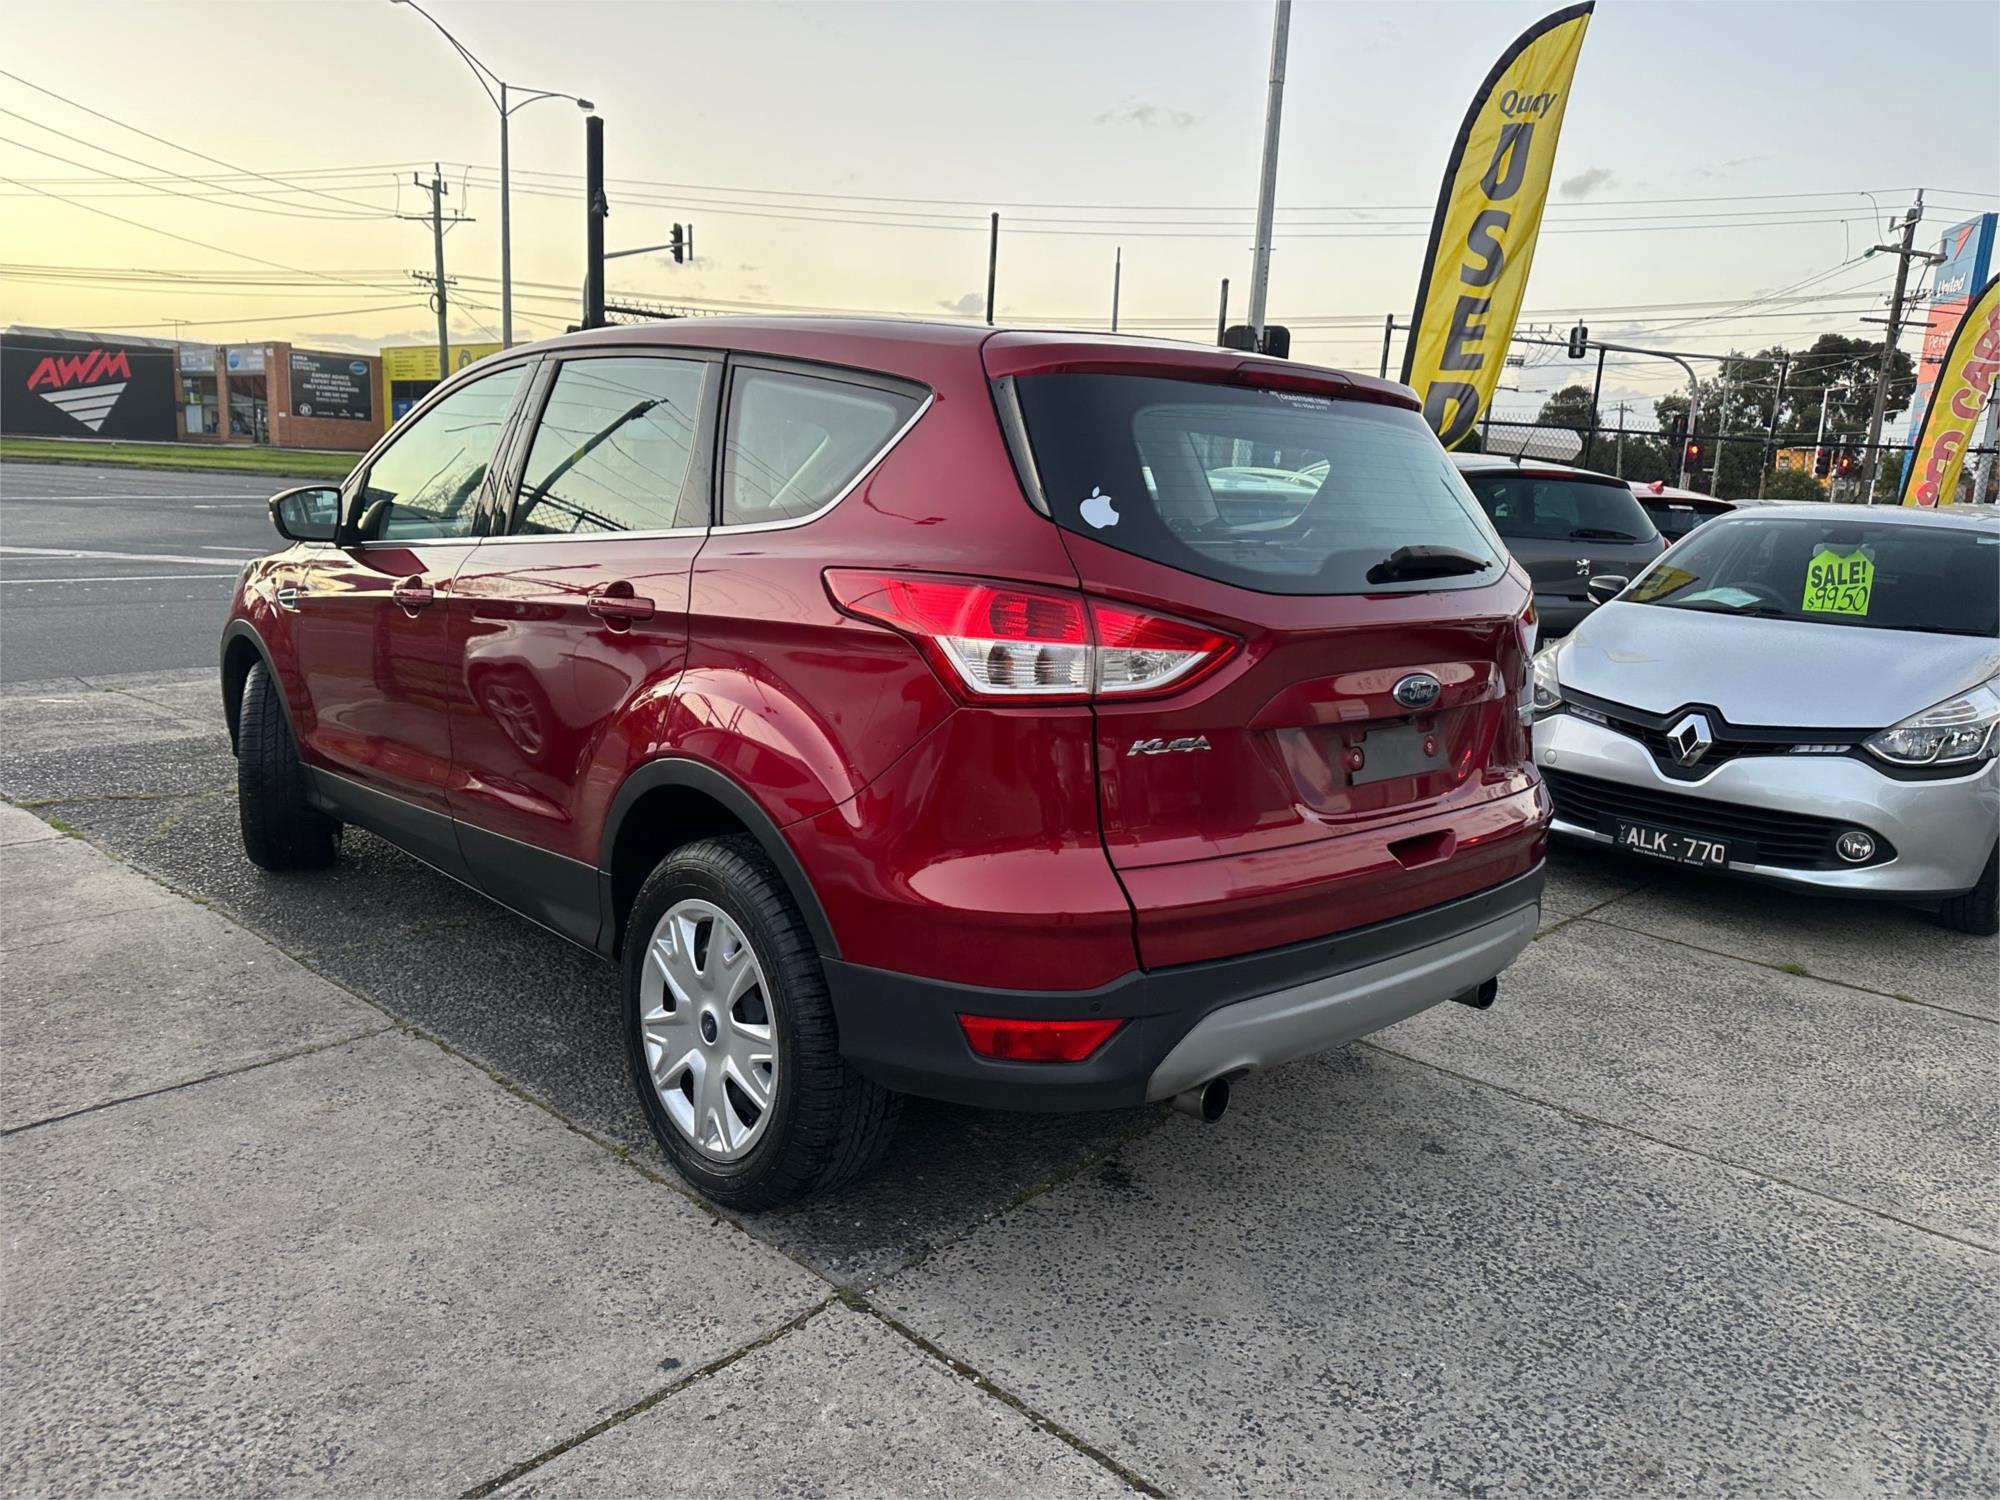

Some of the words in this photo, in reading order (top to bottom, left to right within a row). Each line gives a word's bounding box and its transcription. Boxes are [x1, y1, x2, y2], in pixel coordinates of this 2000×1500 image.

[1422, 122, 1535, 450] USED
[26, 348, 132, 392] AWM
[1811, 561, 1866, 588] SALE!
[1409, 681, 1434, 700] Ford
